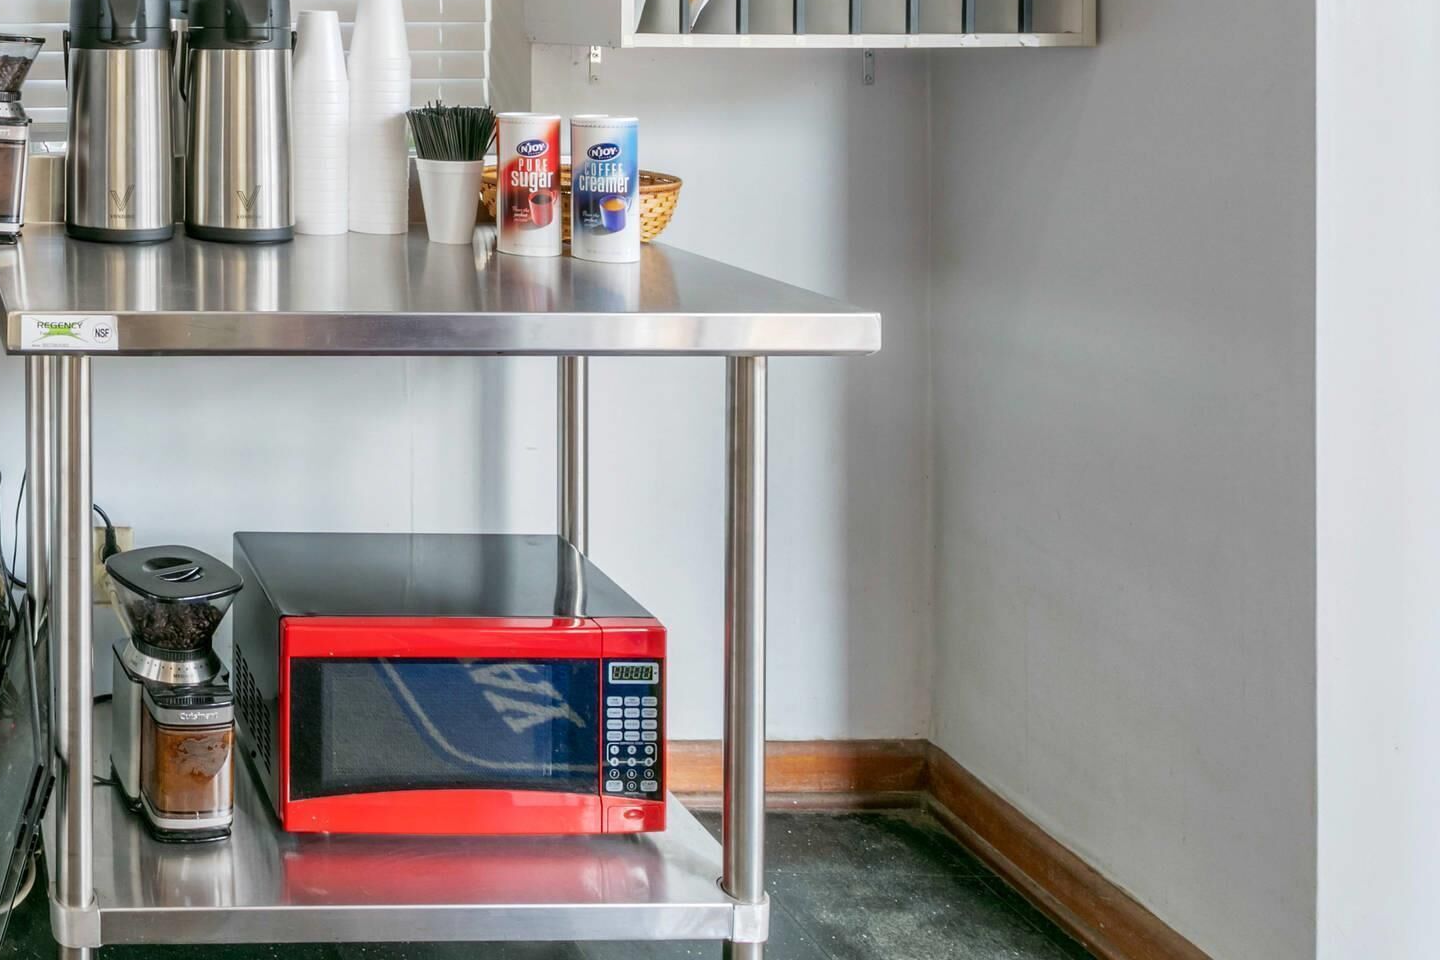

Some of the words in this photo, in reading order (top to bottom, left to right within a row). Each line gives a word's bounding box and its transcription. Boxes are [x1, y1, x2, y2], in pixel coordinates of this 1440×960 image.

[518, 159, 548, 172] PURE
[584, 162, 624, 176] COFFEE
[511, 170, 554, 192] sugar
[579, 175, 630, 193] creamer
[95, 328, 110, 338] NSF
